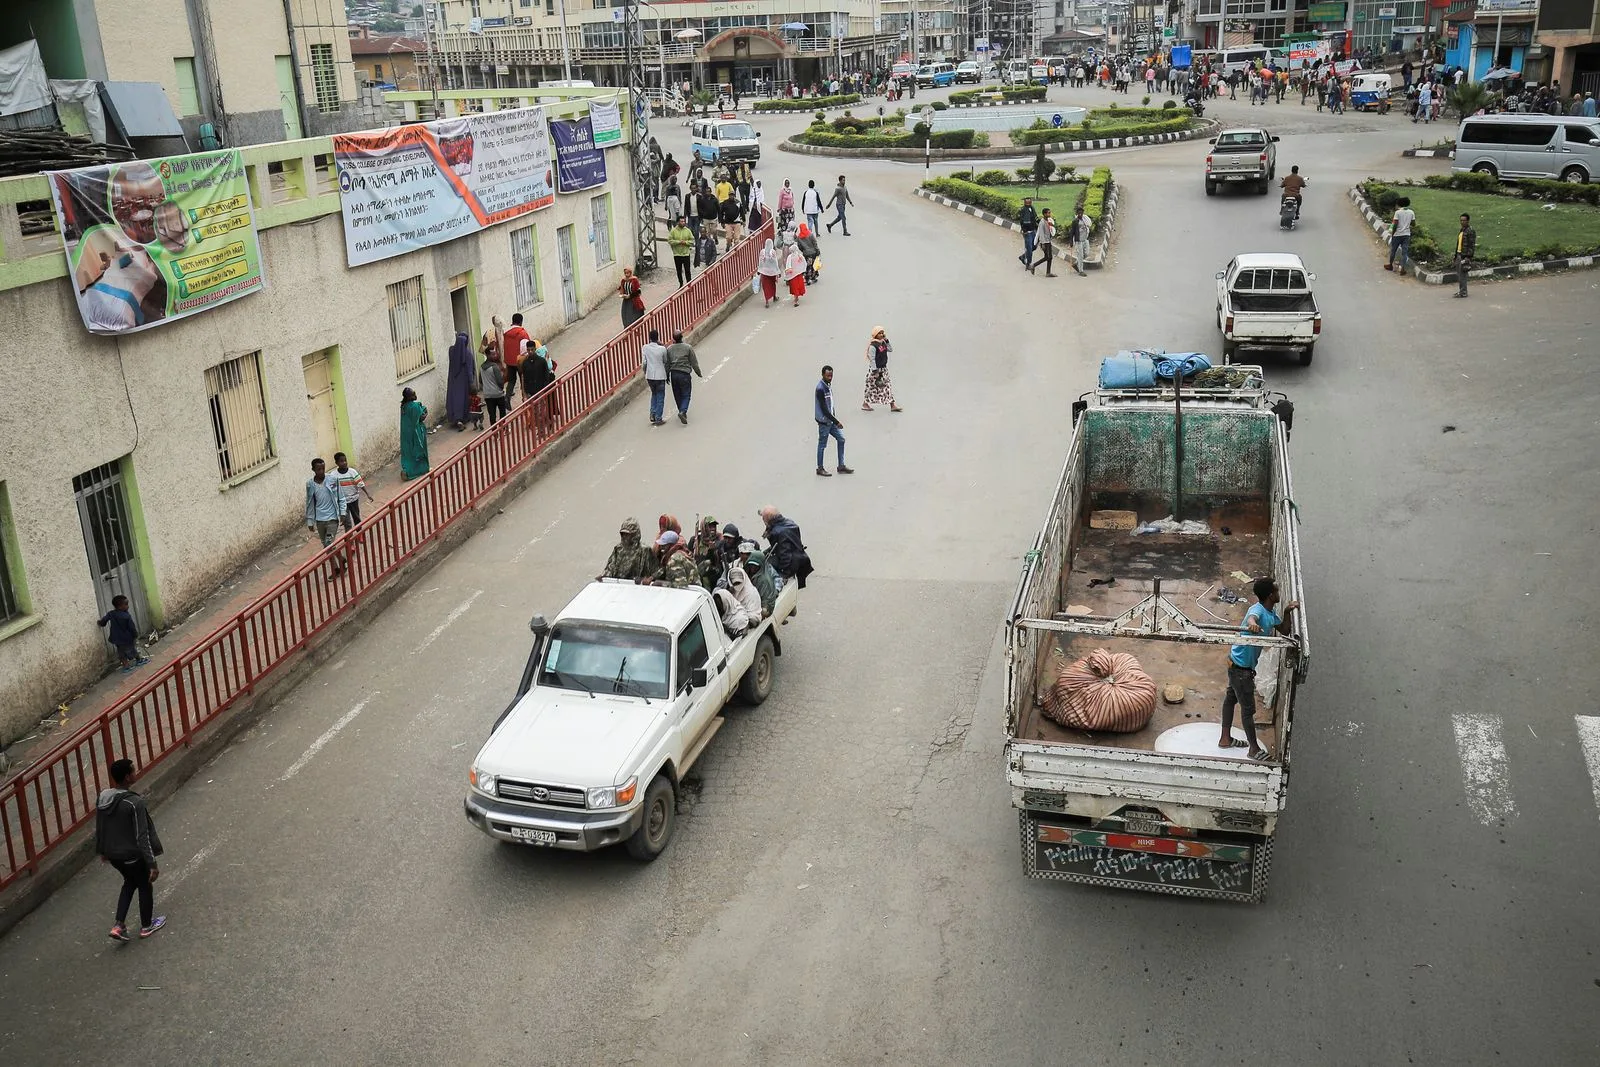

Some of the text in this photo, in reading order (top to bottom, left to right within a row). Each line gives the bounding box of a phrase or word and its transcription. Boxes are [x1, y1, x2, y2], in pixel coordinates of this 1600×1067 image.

[357, 159, 376, 169] COLLEGE
[377, 159, 383, 167] OF
[400, 166, 419, 184] ልማት
